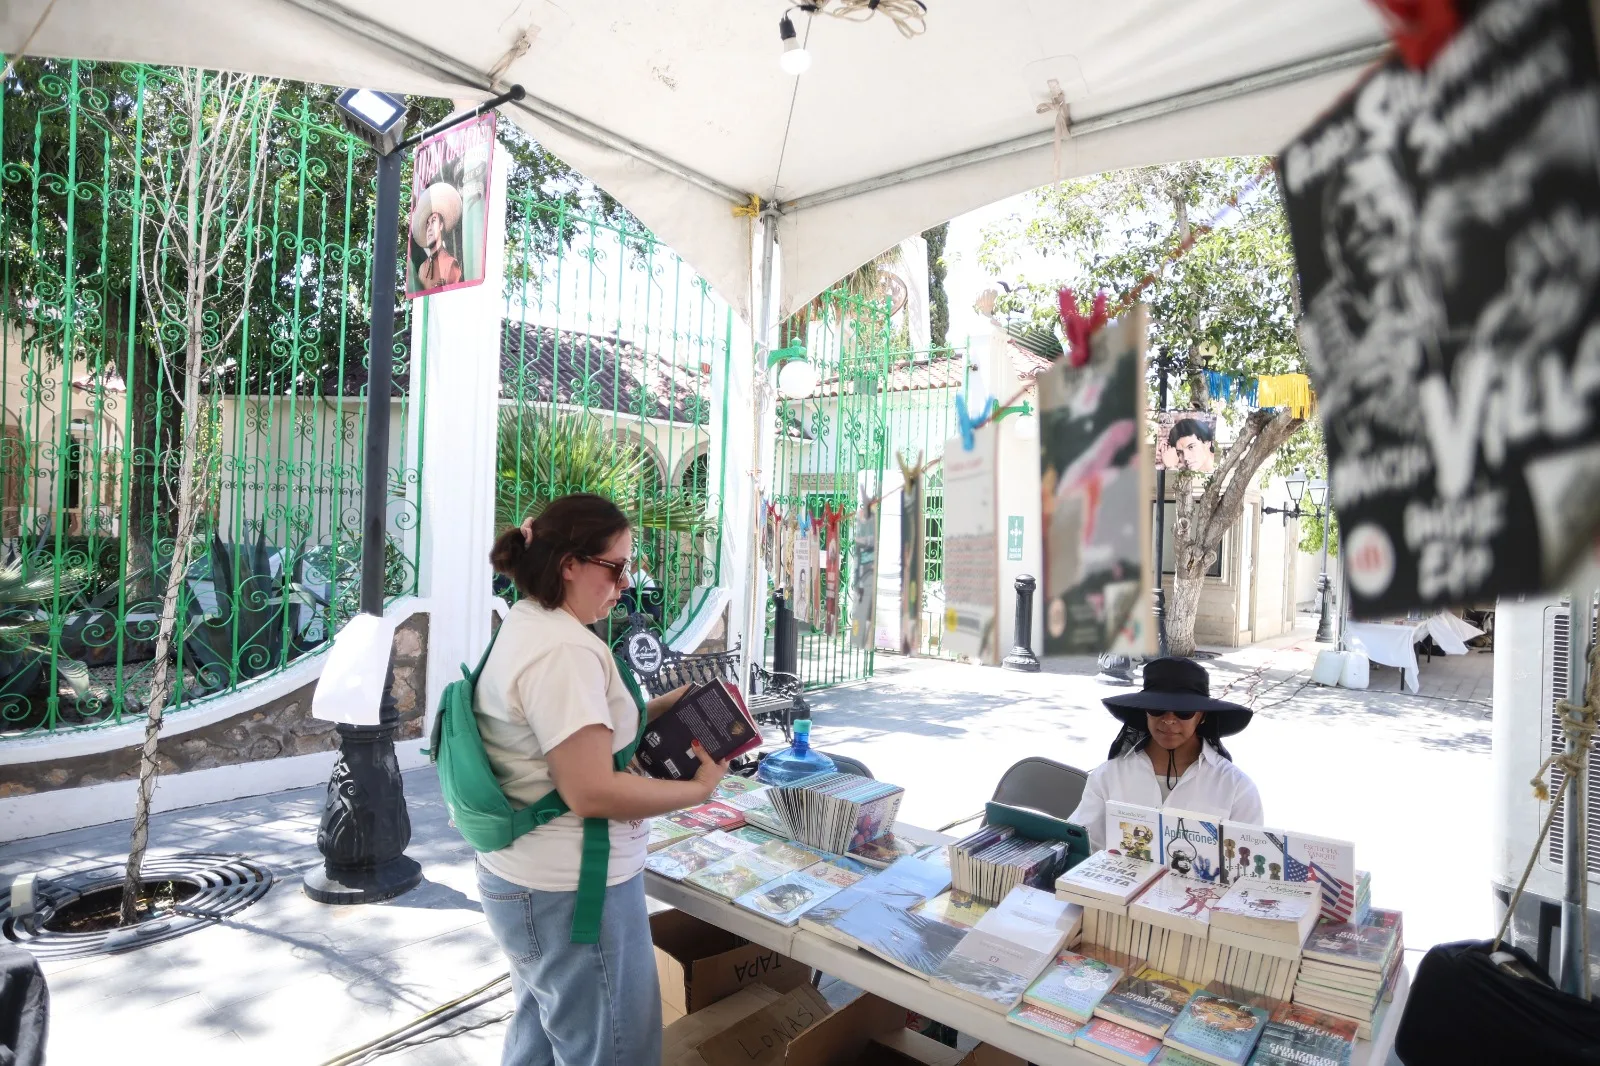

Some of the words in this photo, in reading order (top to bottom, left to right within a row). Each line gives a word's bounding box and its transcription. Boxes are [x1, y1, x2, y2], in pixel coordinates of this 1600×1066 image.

[1164, 825, 1218, 846] Apariciones
[1240, 834, 1267, 846] Allegro
[734, 951, 782, 982] TAPA
[738, 1006, 814, 1060] LONAS
